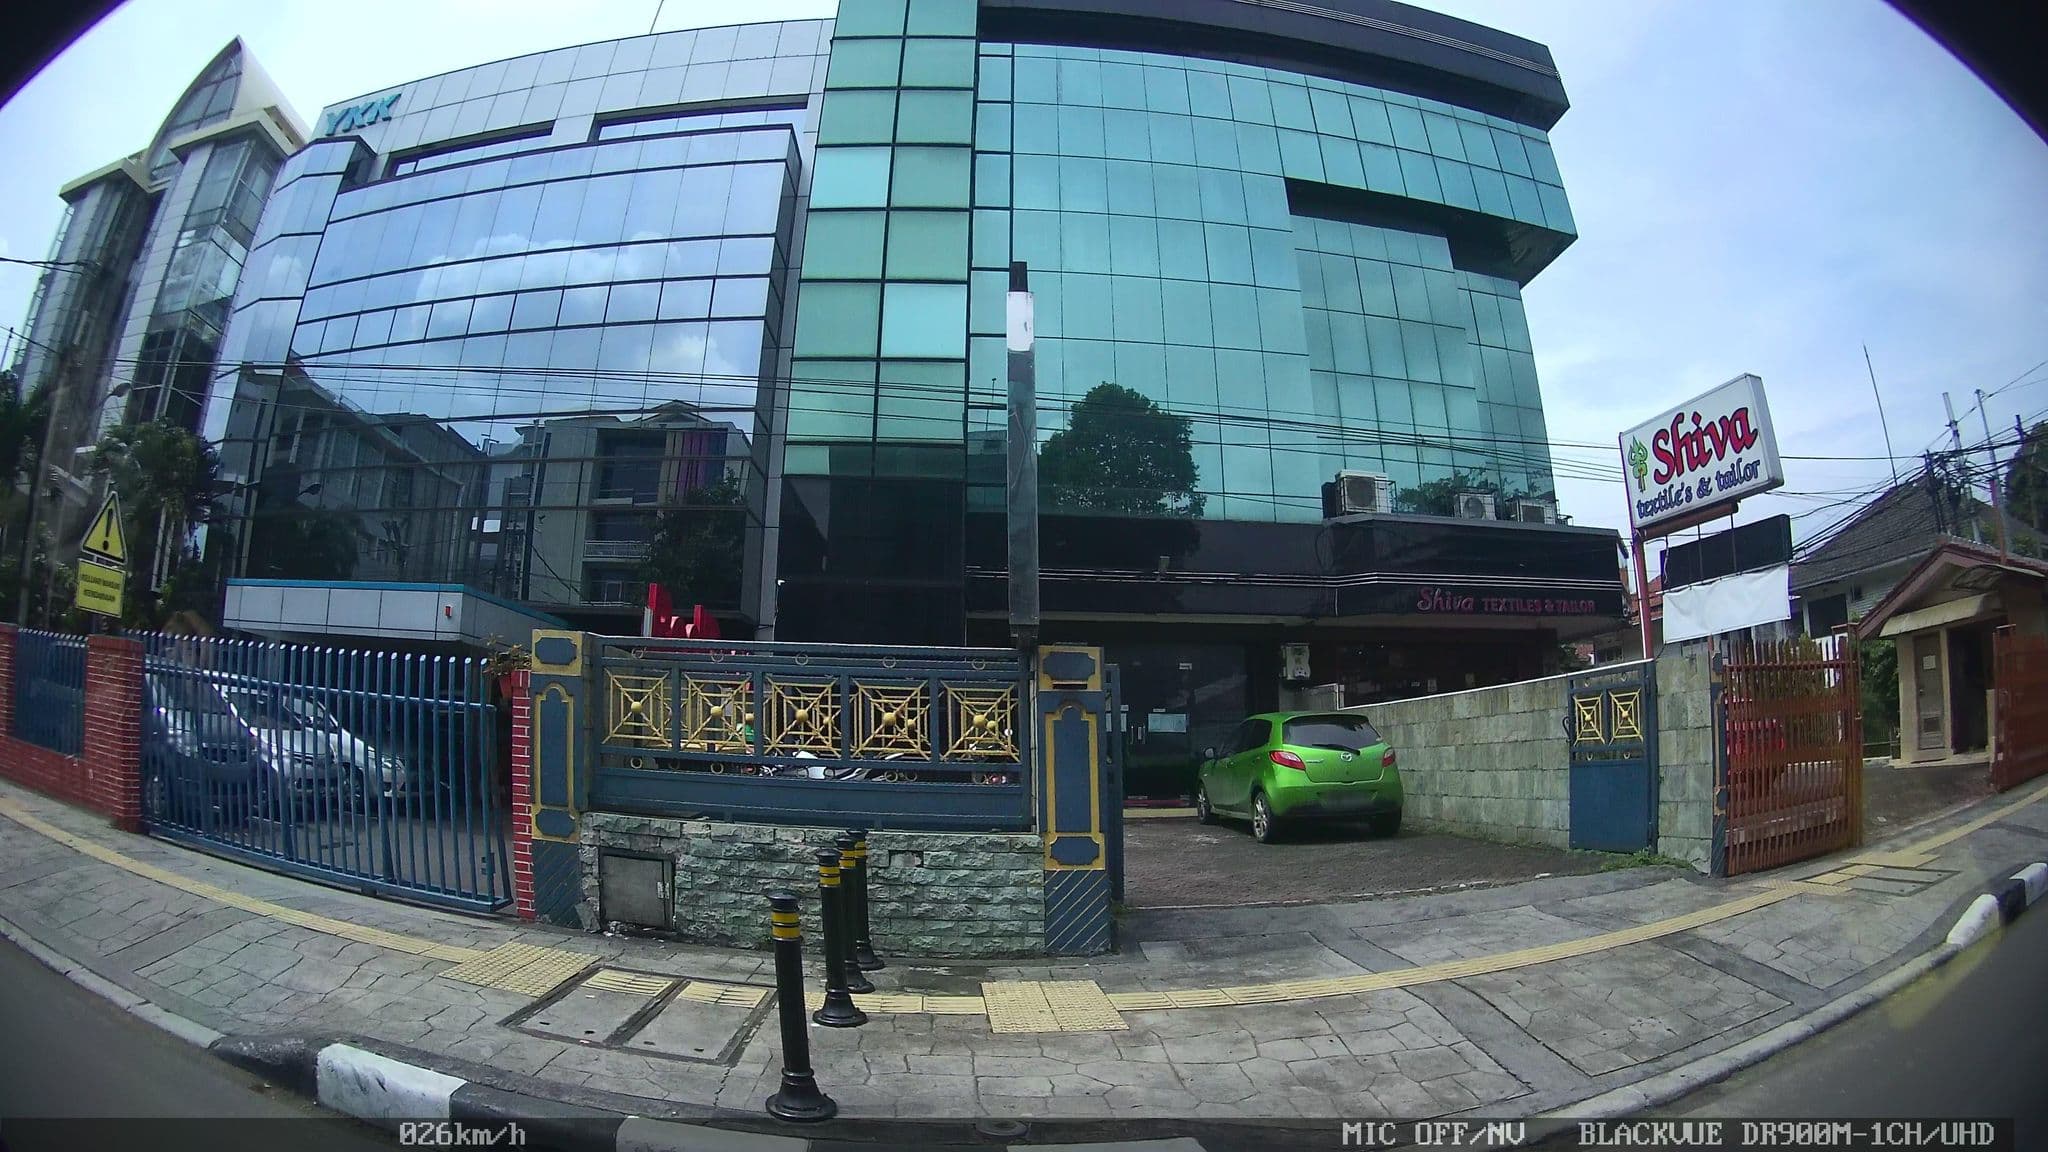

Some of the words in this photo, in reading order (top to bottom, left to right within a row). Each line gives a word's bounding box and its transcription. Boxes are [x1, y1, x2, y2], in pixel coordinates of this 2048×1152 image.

[325, 93, 402, 136] YKK
[1652, 406, 1759, 485] Shiva
[1636, 482, 1693, 519] textile's
[1696, 477, 1713, 499] &
[1715, 457, 1761, 492] tailor
[1416, 586, 1475, 612] Shiva
[1482, 597, 1542, 613] TEXTILES
